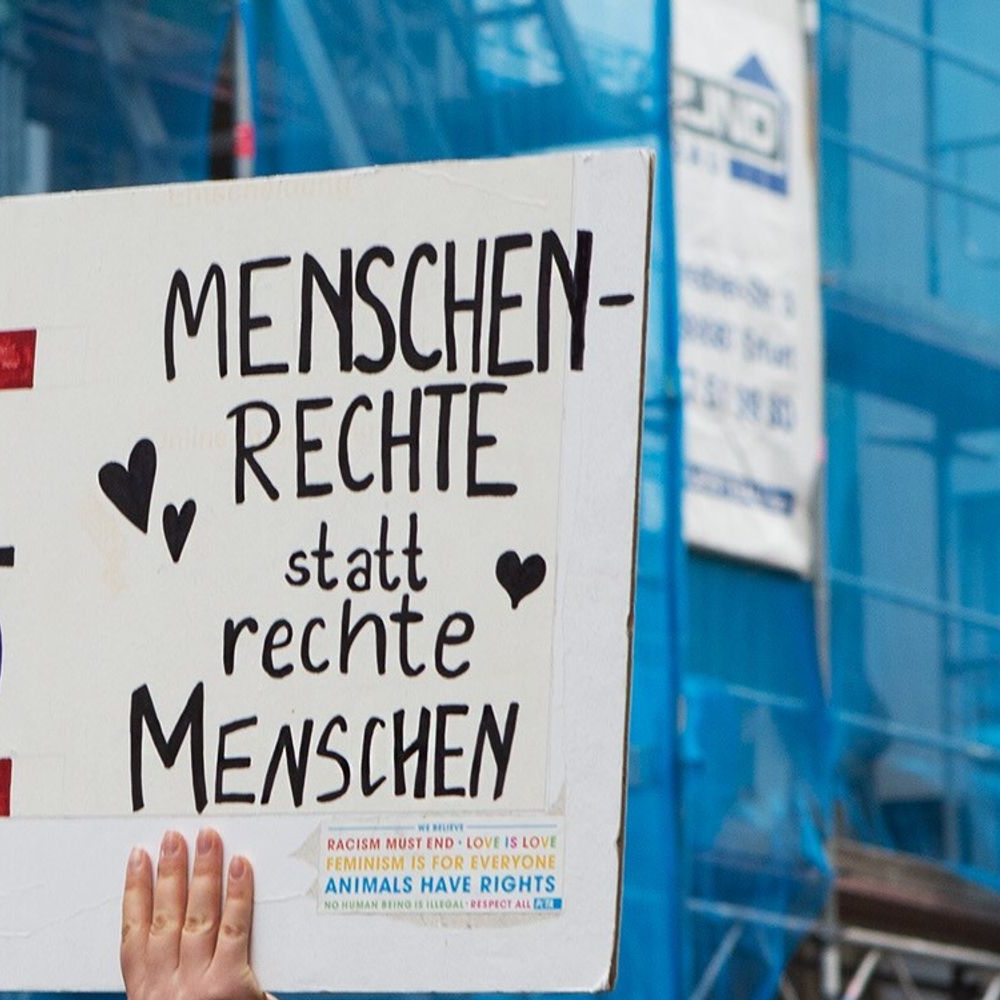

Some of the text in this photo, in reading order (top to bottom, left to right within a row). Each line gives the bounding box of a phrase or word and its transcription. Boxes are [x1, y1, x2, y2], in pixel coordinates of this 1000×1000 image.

[164, 230, 635, 382] MENSCHEN-
[226, 382, 518, 505] RECHTE
[285, 512, 428, 593] statt
[222, 593, 475, 679] rechte
[129, 681, 520, 815] MENSCHEN
[327, 836, 557, 851] RACISM MUST END LOVE IS LOVE
[417, 823, 464, 832] WE BELIEVE
[324, 874, 556, 895] ANIMALS HAVE RIGHTS
[326, 854, 556, 871] FEMINISM IS FOR EVERYONE
[324, 900, 339, 910] NO
[341, 900, 379, 910] HUMAN
[381, 900, 412, 910] BEING
[426, 899, 465, 910] ILLEGAL
[470, 899, 512, 910] RESPECT
[515, 899, 531, 909] ALL
